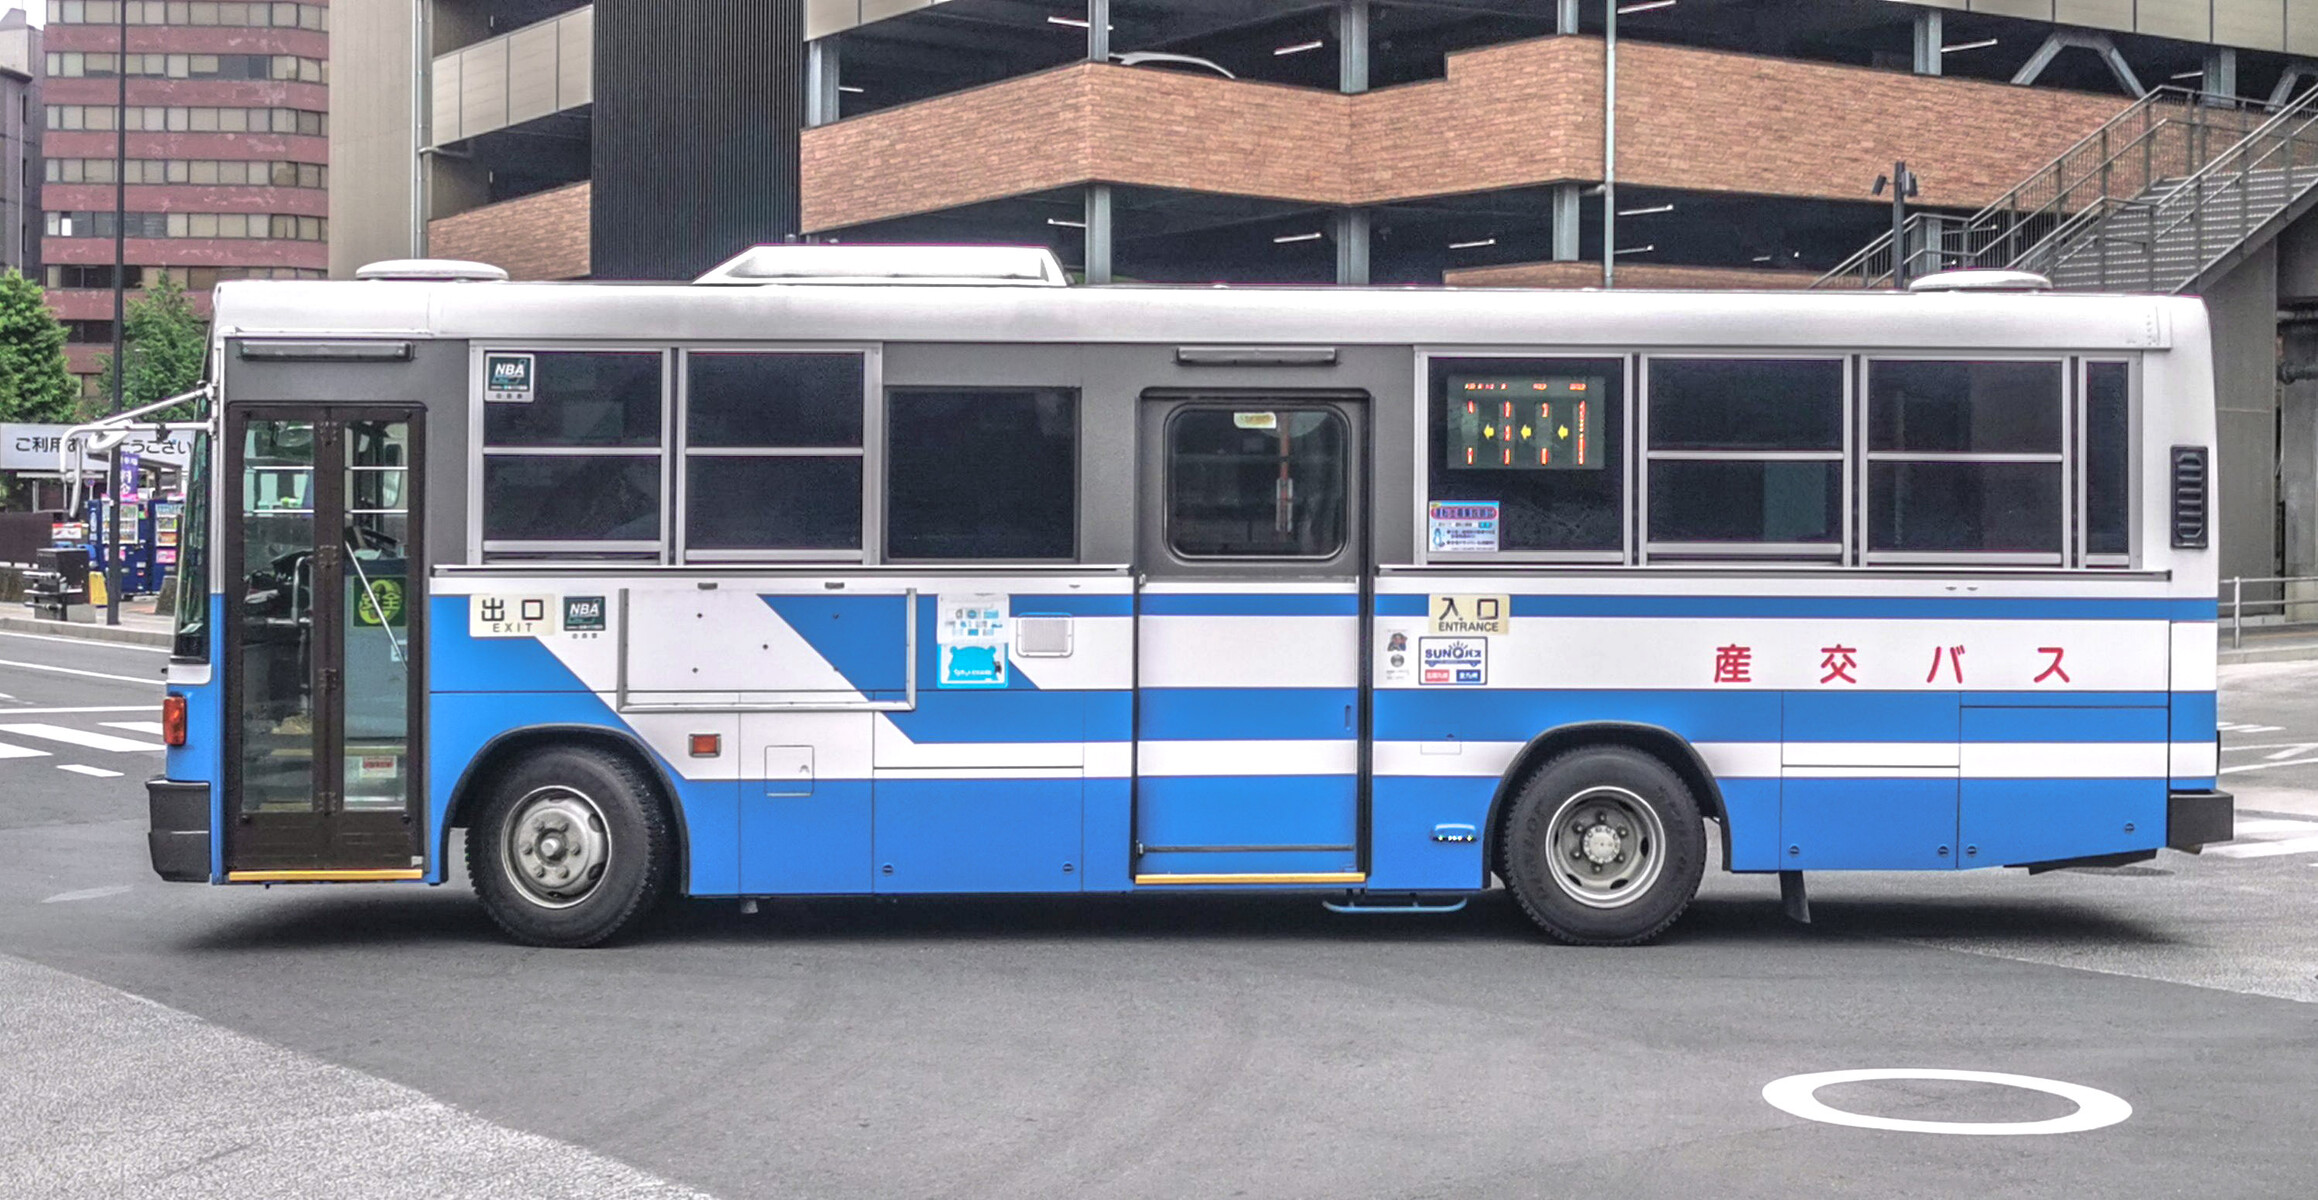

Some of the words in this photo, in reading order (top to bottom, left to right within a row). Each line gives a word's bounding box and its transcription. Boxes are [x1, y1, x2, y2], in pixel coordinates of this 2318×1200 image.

[495, 363, 525, 377] NBA
[481, 597, 544, 622] 出口
[569, 603, 600, 617] NBA
[1438, 597, 1499, 621] 入口
[493, 623, 533, 633] EXIT
[1438, 621, 1499, 633] ENTRANCE
[1714, 643, 2071, 684] 産交バス
